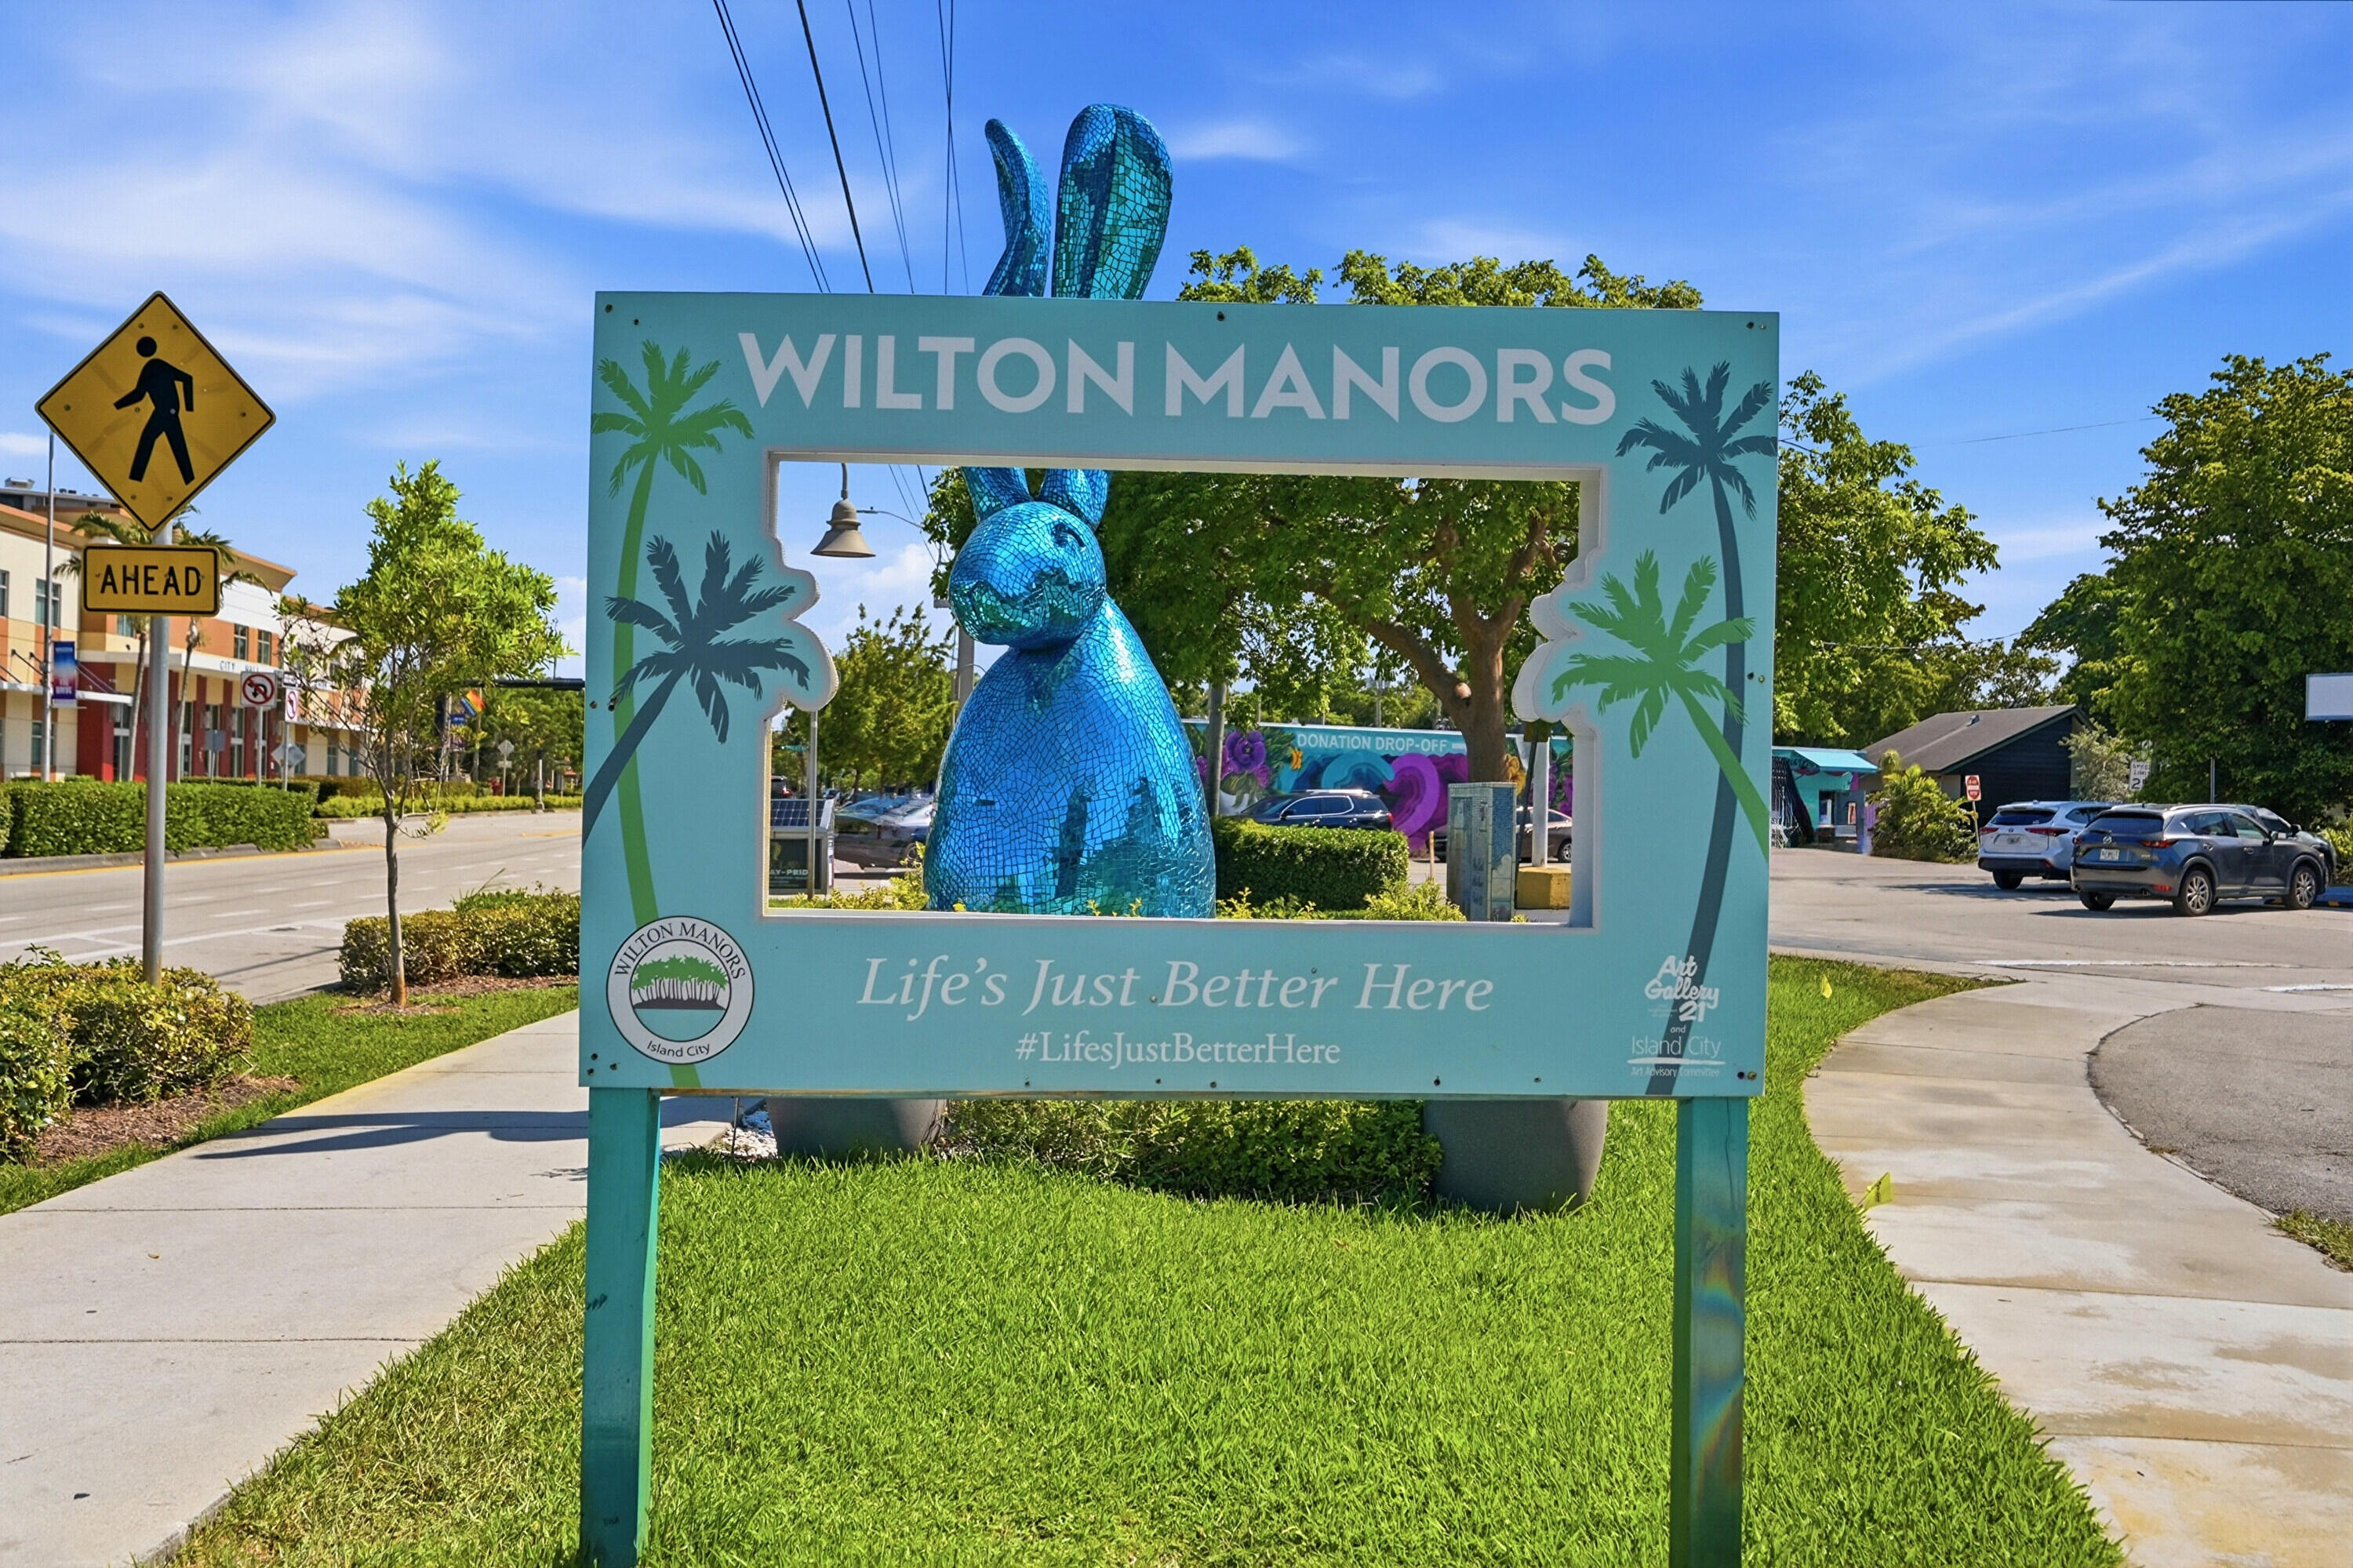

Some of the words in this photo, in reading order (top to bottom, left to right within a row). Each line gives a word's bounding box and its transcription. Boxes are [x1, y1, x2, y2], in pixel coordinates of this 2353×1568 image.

[738, 333, 1135, 417] WILTON
[1165, 340, 1617, 425] MANORS
[100, 564, 202, 596] AHEAD
[220, 660, 235, 671] CITY
[1297, 733, 1371, 750] DONATION
[1376, 737, 1448, 752] DROP-OFF
[614, 922, 674, 977] WILTON
[678, 922, 746, 980] MANORS
[1656, 955, 1698, 980] Art
[856, 955, 1008, 1021] Life's
[1021, 959, 1140, 1017] Just
[1158, 960, 1338, 1010] Better
[1355, 963, 1494, 1011] Here
[1644, 977, 1720, 1009] Gallery
[1678, 1000, 1706, 1022] 21
[1670, 1024, 1686, 1034] and
[647, 1040, 683, 1057] Island
[686, 1043, 710, 1057] City
[1015, 1030, 1340, 1070] #LifesJustBetterHere
[1631, 1035, 1682, 1055] Island
[1688, 1035, 1721, 1058] City
[1645, 1067, 1678, 1077] Advisory
